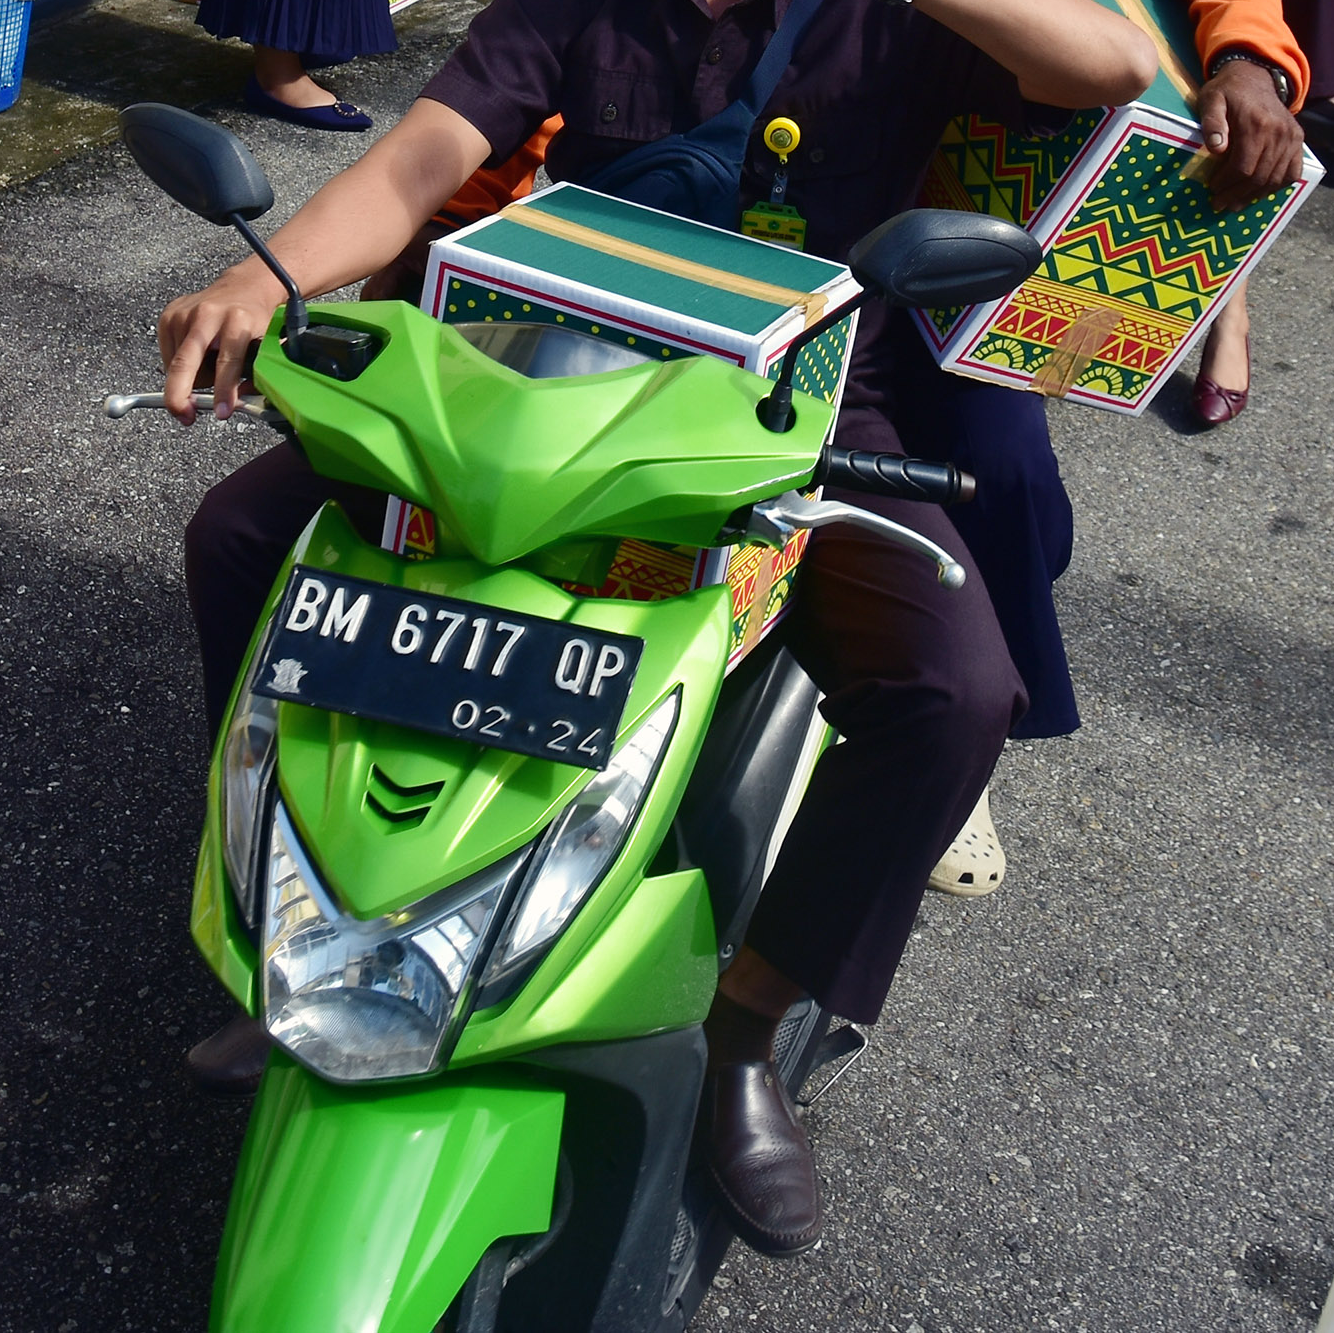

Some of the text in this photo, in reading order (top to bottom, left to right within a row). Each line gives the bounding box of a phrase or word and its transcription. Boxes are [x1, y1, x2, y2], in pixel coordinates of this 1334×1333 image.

[284, 577, 626, 698] BM 6717 QP
